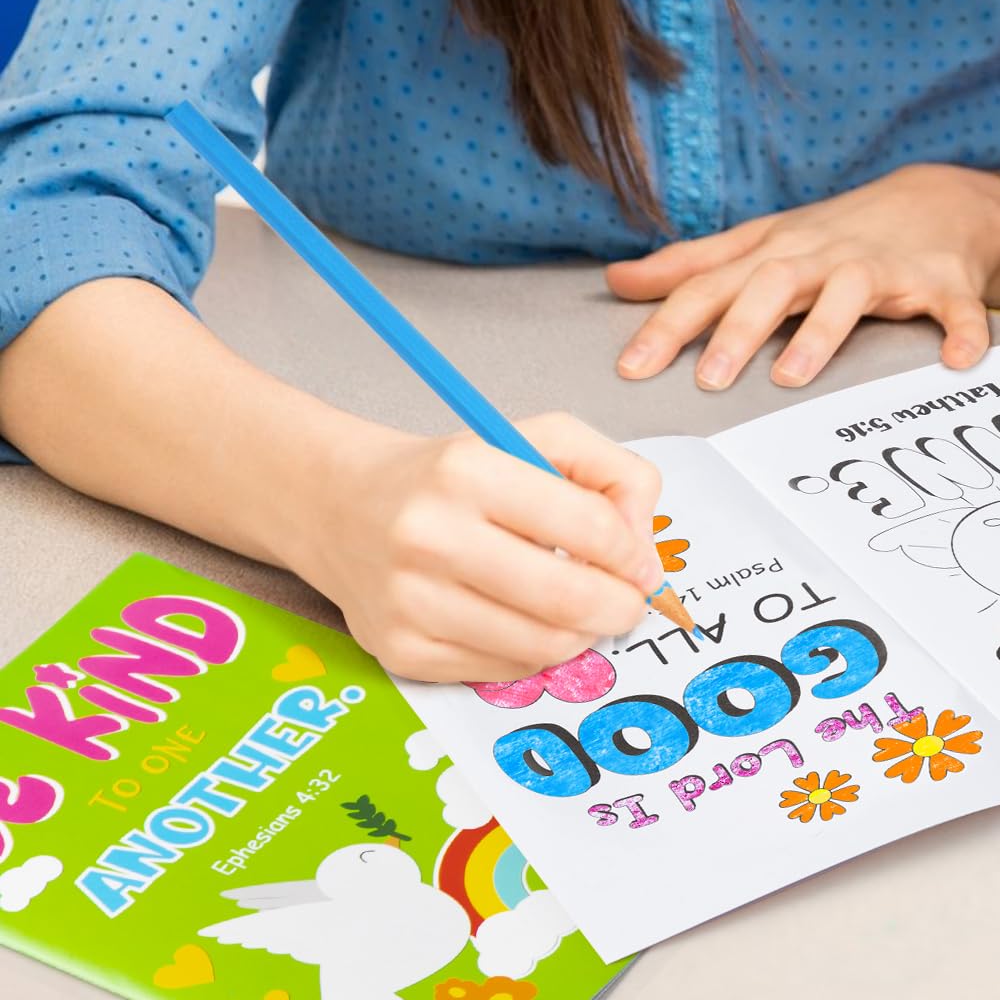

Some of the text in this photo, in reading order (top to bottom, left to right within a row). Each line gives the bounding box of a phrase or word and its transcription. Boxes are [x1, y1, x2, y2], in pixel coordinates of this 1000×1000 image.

[835, 417, 892, 442] 5:16
[706, 558, 783, 592] Psalm
[753, 582, 837, 623] TO
[612, 613, 726, 664] ALL.
[493, 618, 888, 798] GOOD
[814, 692, 925, 742] The
[88, 724, 206, 812] TO ONE
[669, 738, 804, 812] Lord
[74, 684, 366, 918] ANOTHER.
[212, 769, 342, 877] Ephesians 4:32
